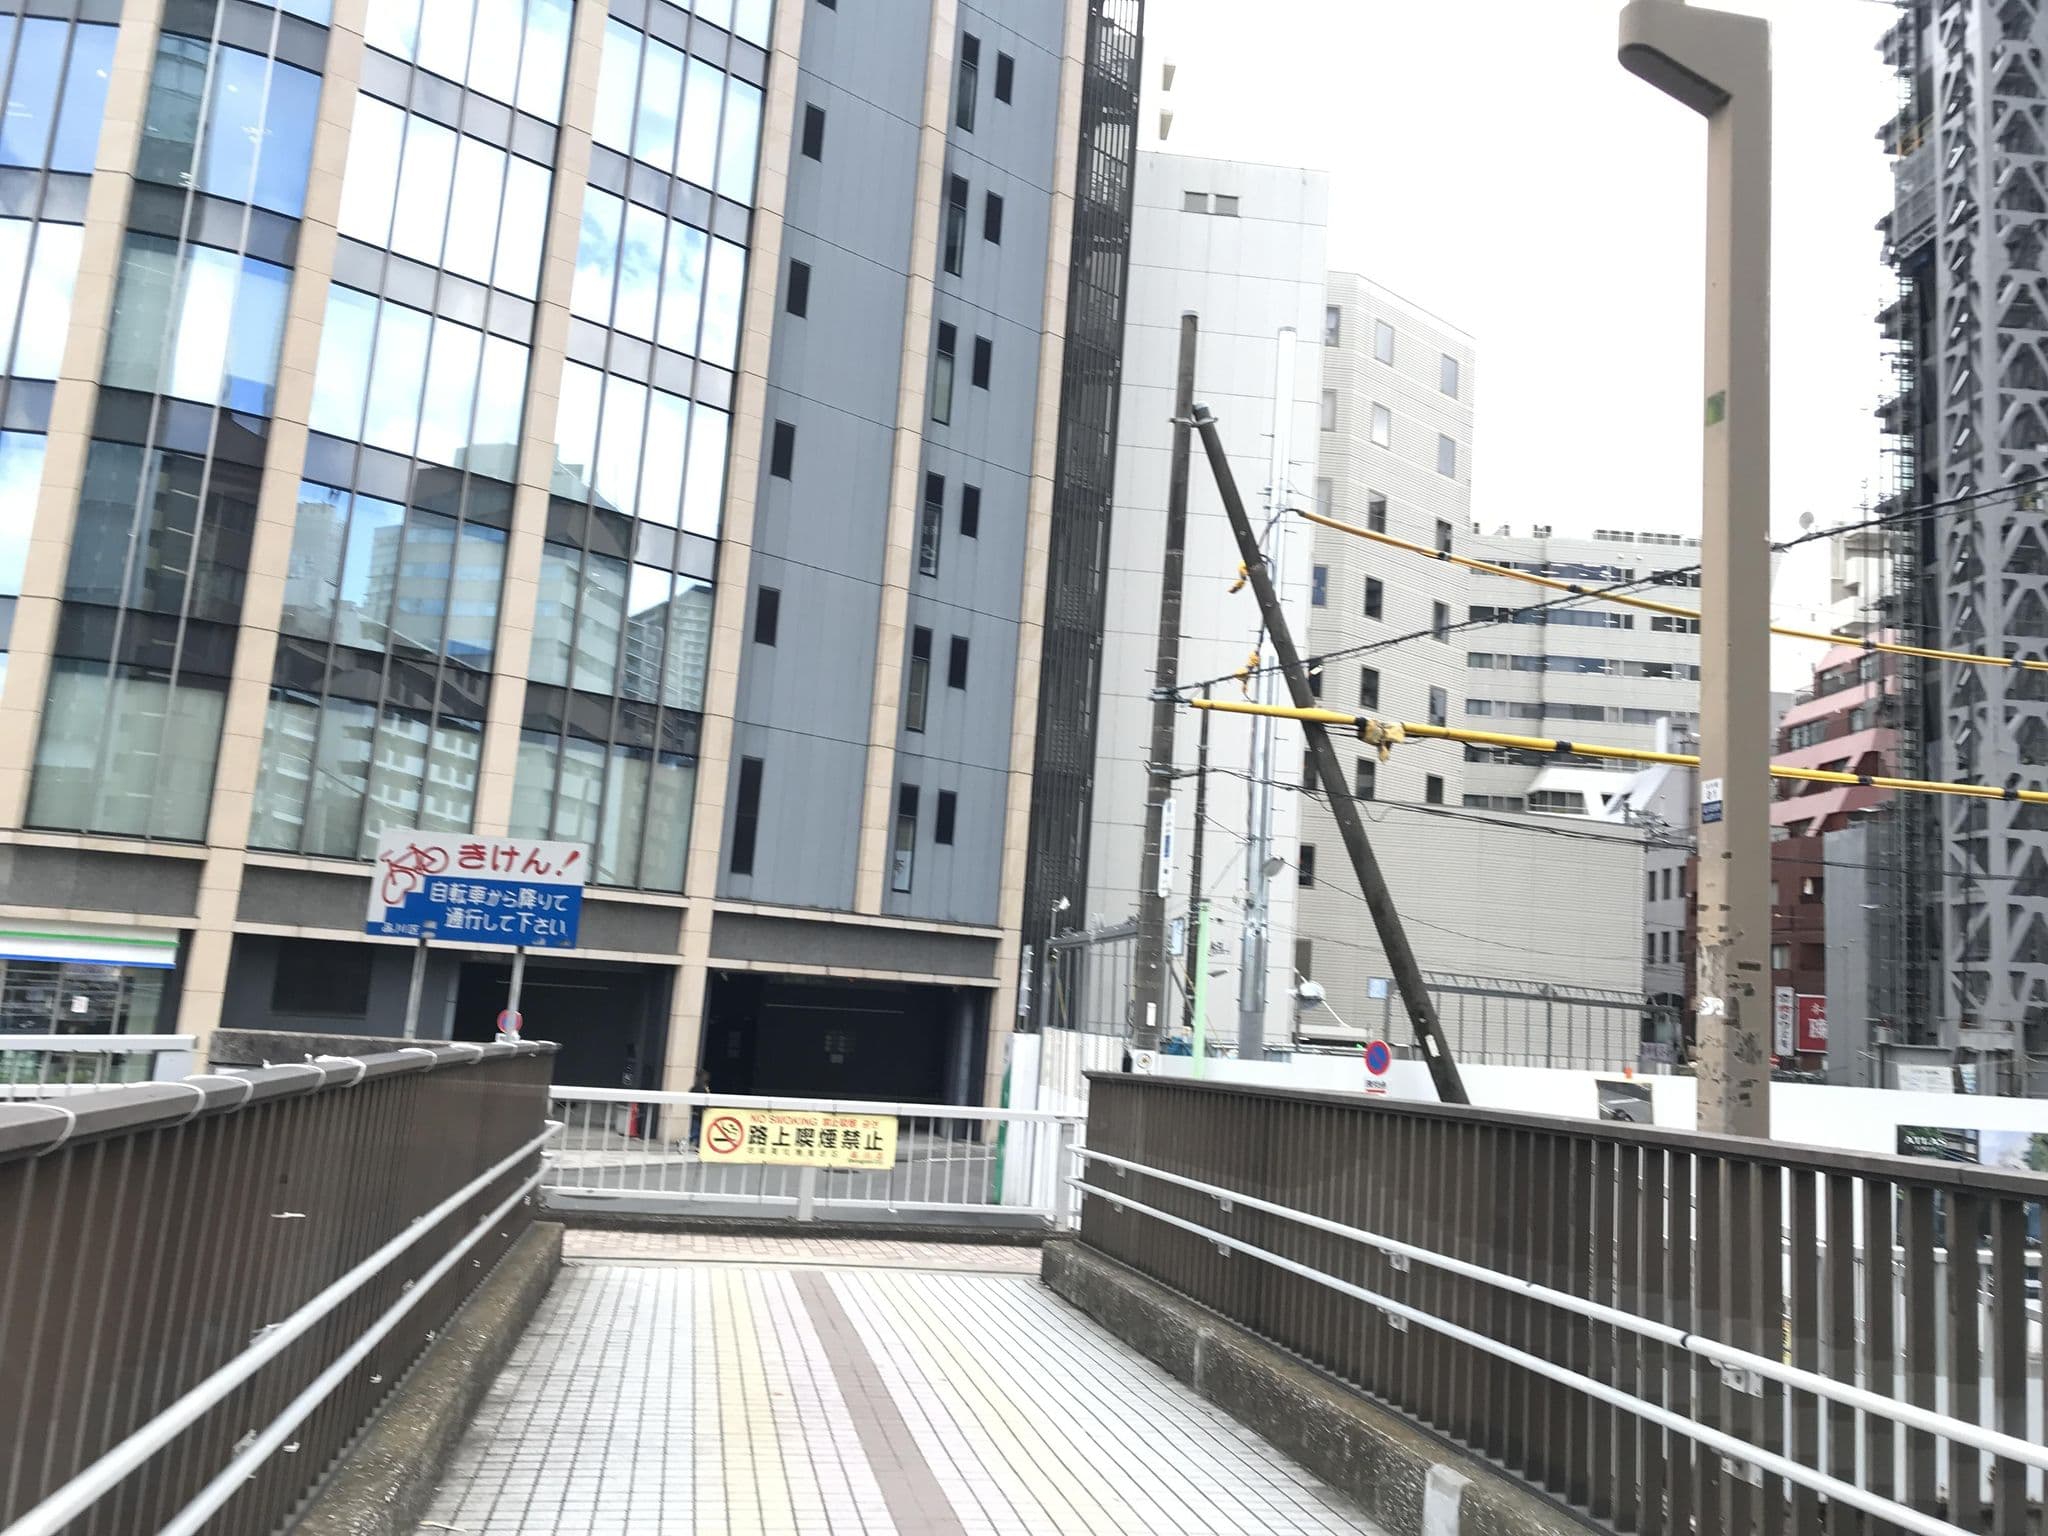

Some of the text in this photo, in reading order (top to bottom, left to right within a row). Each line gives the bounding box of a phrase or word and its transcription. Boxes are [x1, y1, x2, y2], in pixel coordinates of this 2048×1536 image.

[428, 881, 570, 912] 自転車から降りて
[443, 907, 568, 935] 通行して下さい
[750, 1114, 818, 1126] NO SMOKING
[747, 1124, 884, 1151] 路上喫煙禁止
